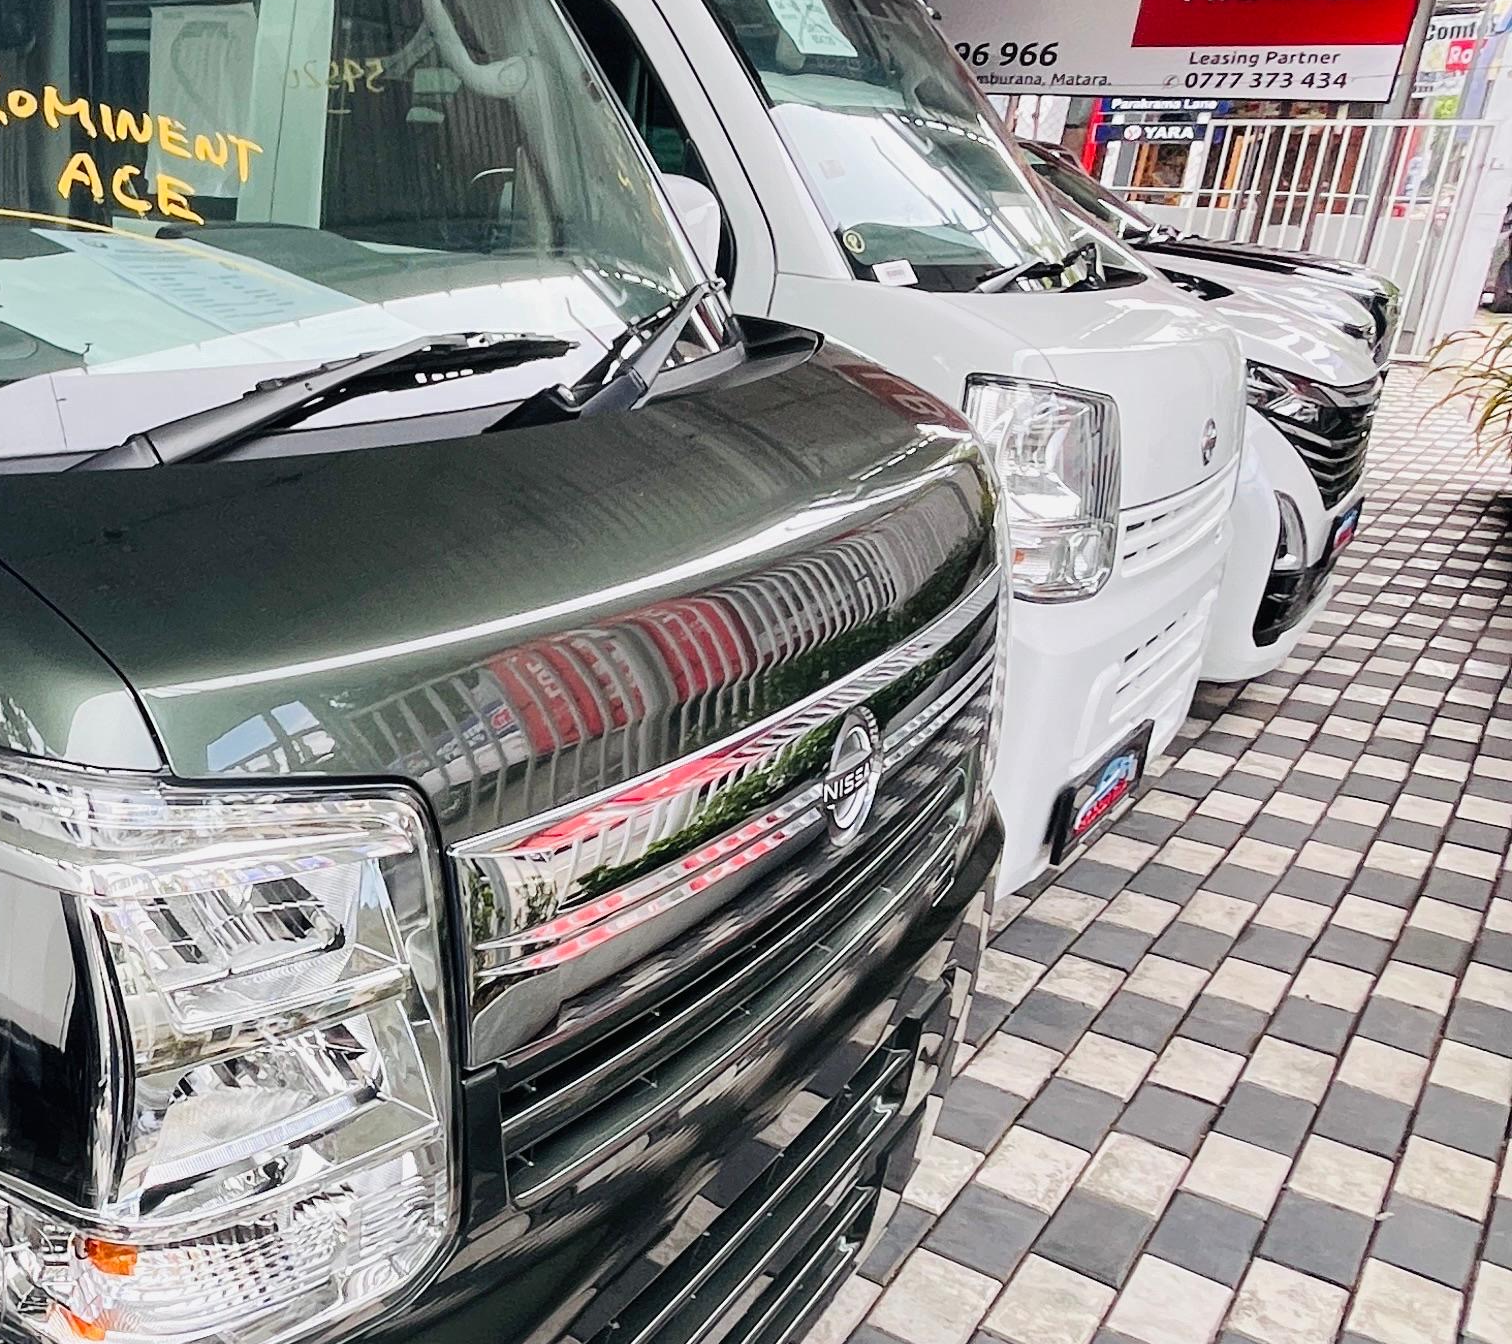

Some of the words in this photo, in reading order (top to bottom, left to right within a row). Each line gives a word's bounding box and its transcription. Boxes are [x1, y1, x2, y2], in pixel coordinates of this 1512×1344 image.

[999, 42, 1059, 67] 966
[1188, 51, 1260, 68] Leasing
[1265, 51, 1342, 65] Partner
[1049, 73, 1113, 88] Matara.
[1184, 72, 1244, 88] 0777
[1248, 72, 1294, 89] 373
[1300, 72, 1348, 89] 434
[1144, 126, 1195, 140] YARA
[58, 152, 206, 226] ACE
